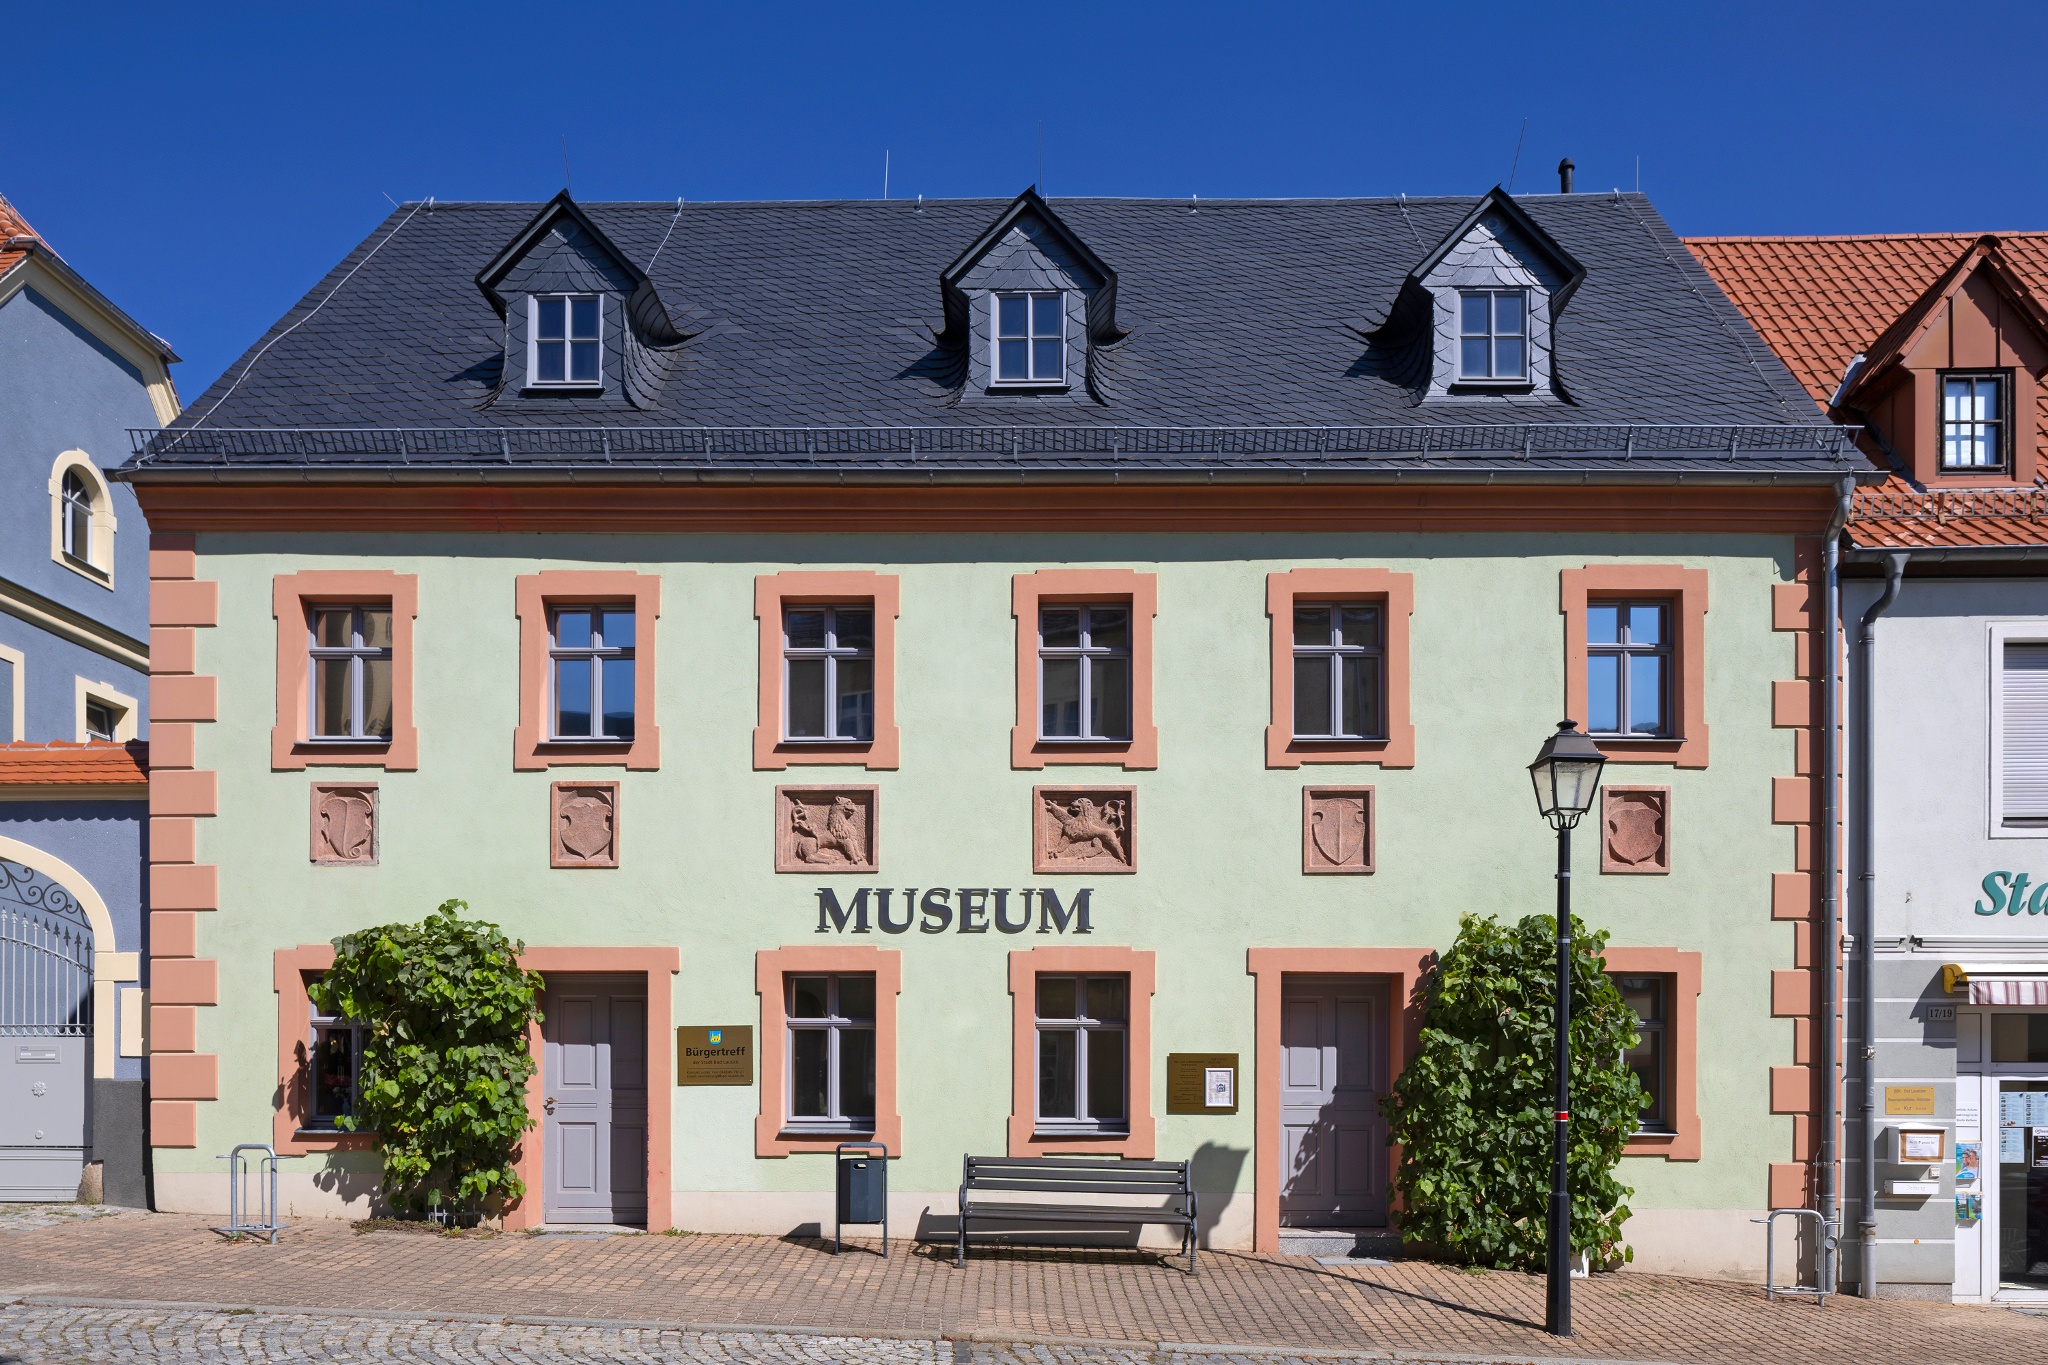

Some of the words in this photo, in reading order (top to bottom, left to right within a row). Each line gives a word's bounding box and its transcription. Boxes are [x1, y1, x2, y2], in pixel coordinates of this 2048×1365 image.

[814, 887, 1095, 935] MUSEUM
[1930, 1008, 1953, 1018] 17/19
[685, 1046, 746, 1059] Bürgertreff
